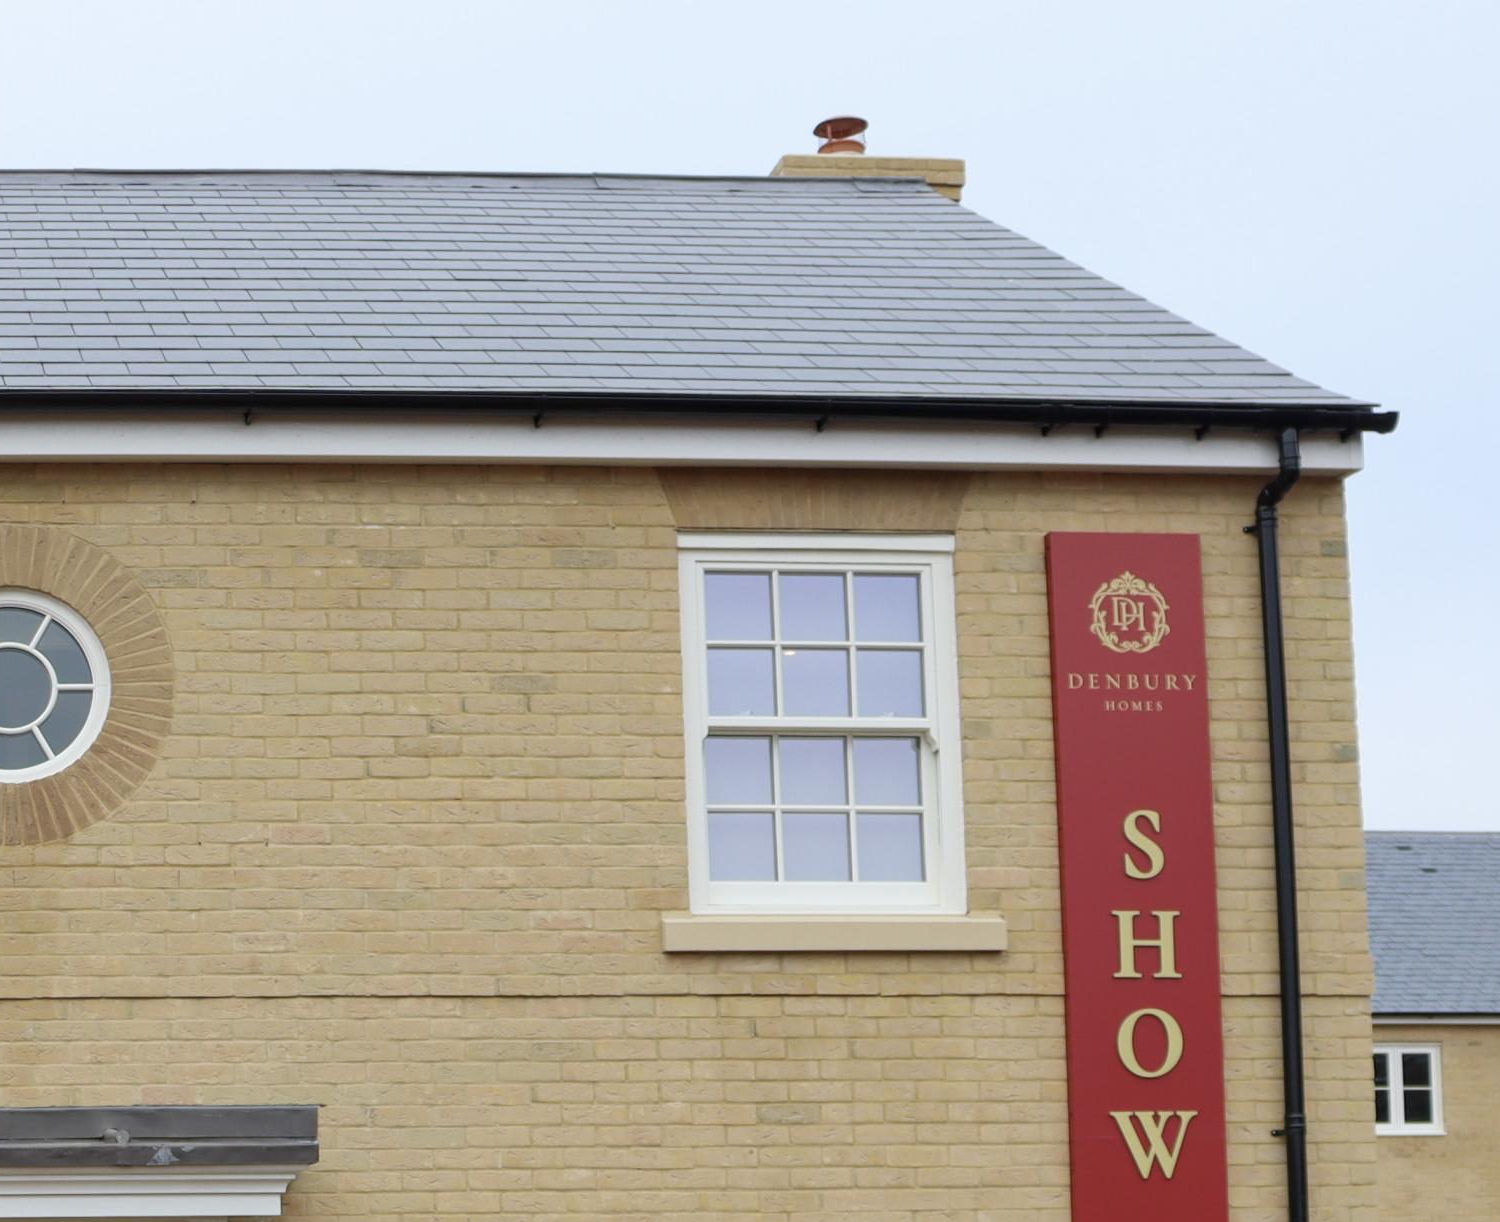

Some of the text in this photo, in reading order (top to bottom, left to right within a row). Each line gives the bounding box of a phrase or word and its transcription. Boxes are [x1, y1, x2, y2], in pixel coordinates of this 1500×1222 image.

[1068, 673, 1197, 690] DENBURY
[1105, 700, 1163, 711] HOMES
[1110, 809, 1198, 1180] SHOW
